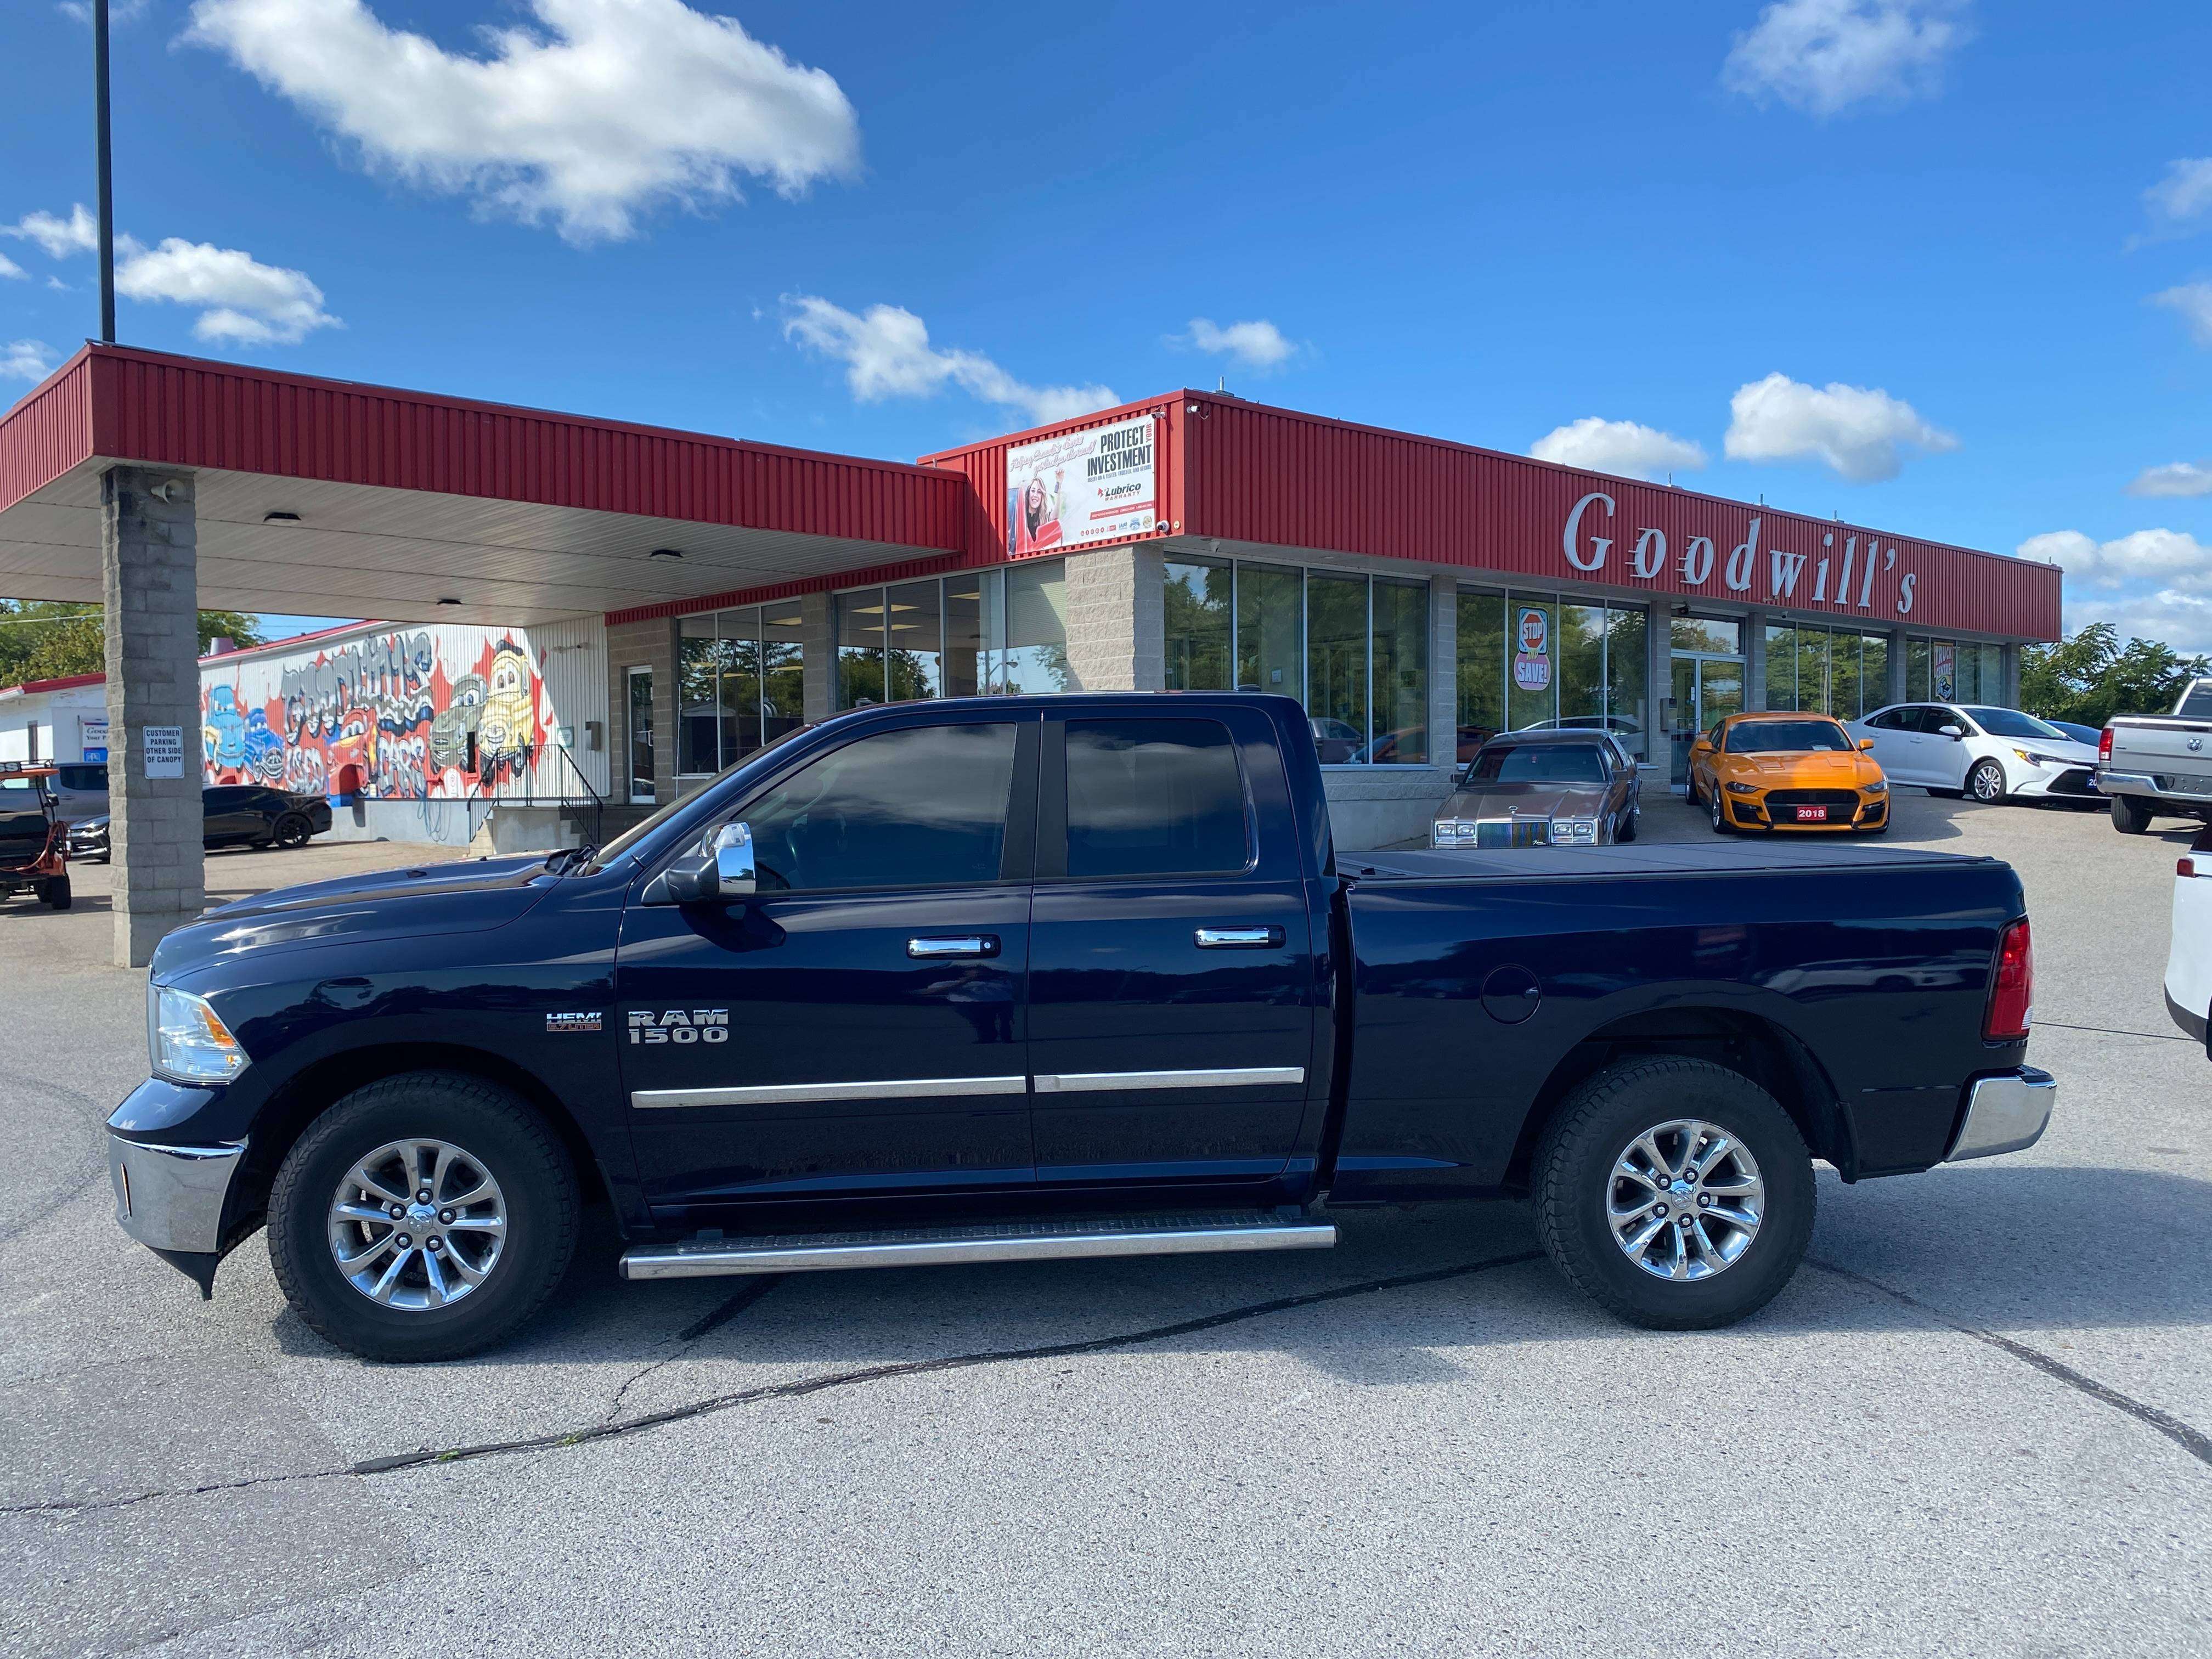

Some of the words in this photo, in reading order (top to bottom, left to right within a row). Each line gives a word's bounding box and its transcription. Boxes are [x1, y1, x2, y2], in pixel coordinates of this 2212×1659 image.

[1101, 425, 1145, 454] PROTECT
[1087, 444, 1152, 477] INVESTMENT
[1105, 483, 1142, 496] Lubrico
[1105, 491, 1141, 501] WARRANTY
[1564, 492, 1916, 613] Goodwill's
[1523, 622, 1543, 640] STOP
[1526, 649, 1538, 661] AND
[1934, 645, 1953, 667] TRUCK
[1517, 662, 1548, 684] SAVE!
[1798, 809, 1825, 817] 2018
[546, 1012, 602, 1023] HEMI
[628, 1009, 729, 1026] RAM
[628, 1026, 729, 1044] 1500
